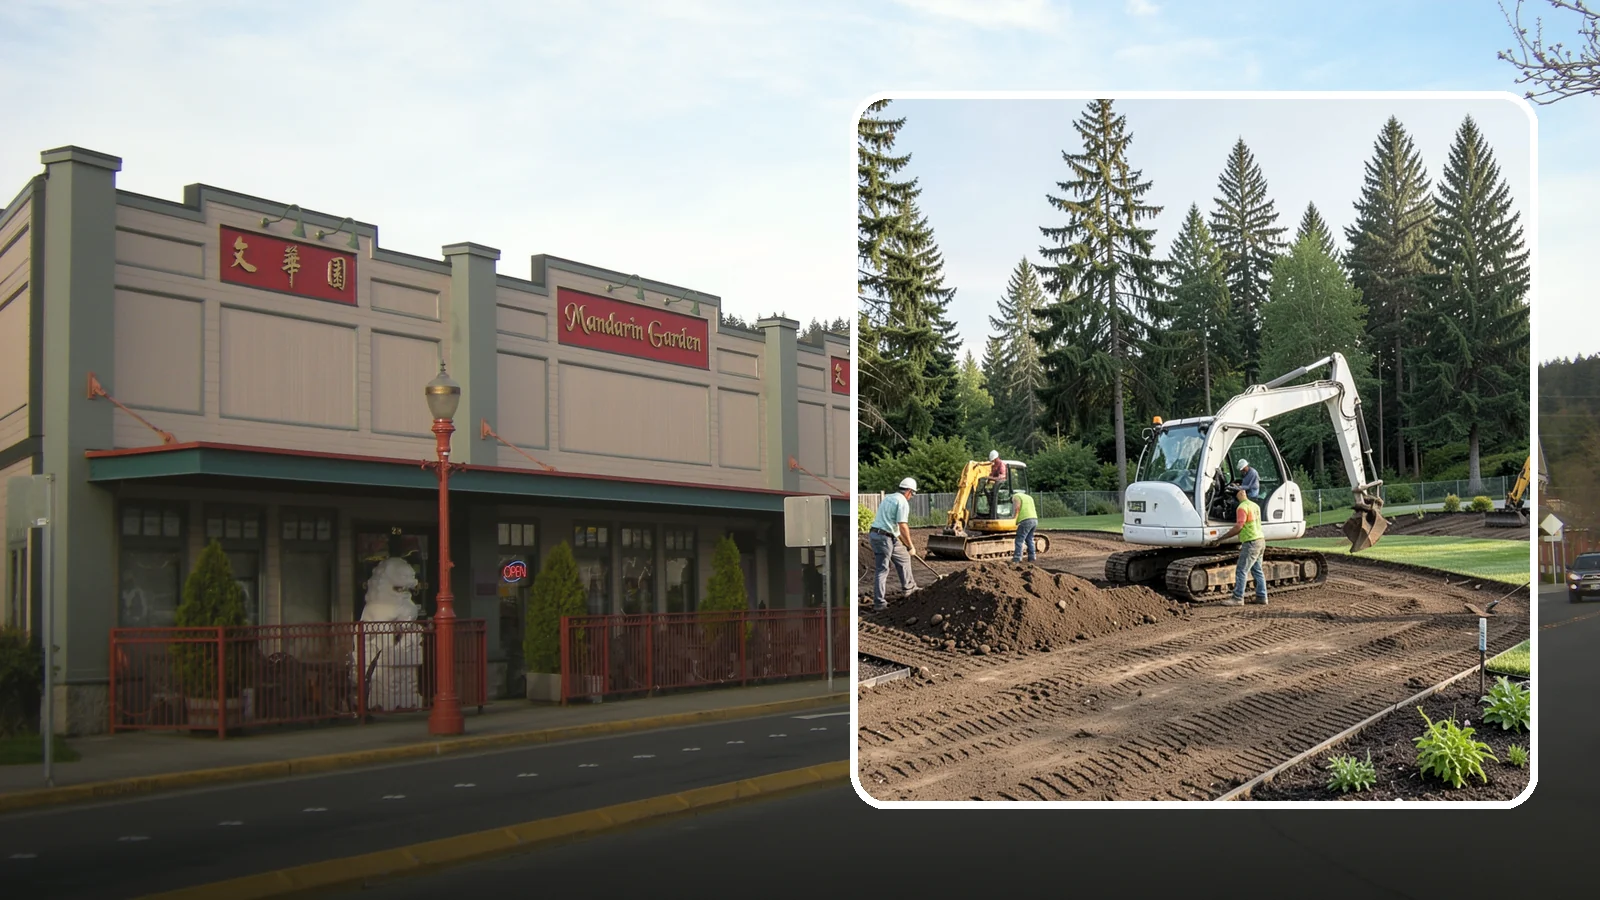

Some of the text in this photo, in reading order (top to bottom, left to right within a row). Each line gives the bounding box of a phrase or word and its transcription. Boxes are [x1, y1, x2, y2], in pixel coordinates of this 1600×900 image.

[231, 235, 346, 291] 文華園
[564, 302, 701, 352] Mandarin Garden
[503, 565, 527, 578] OPEN
